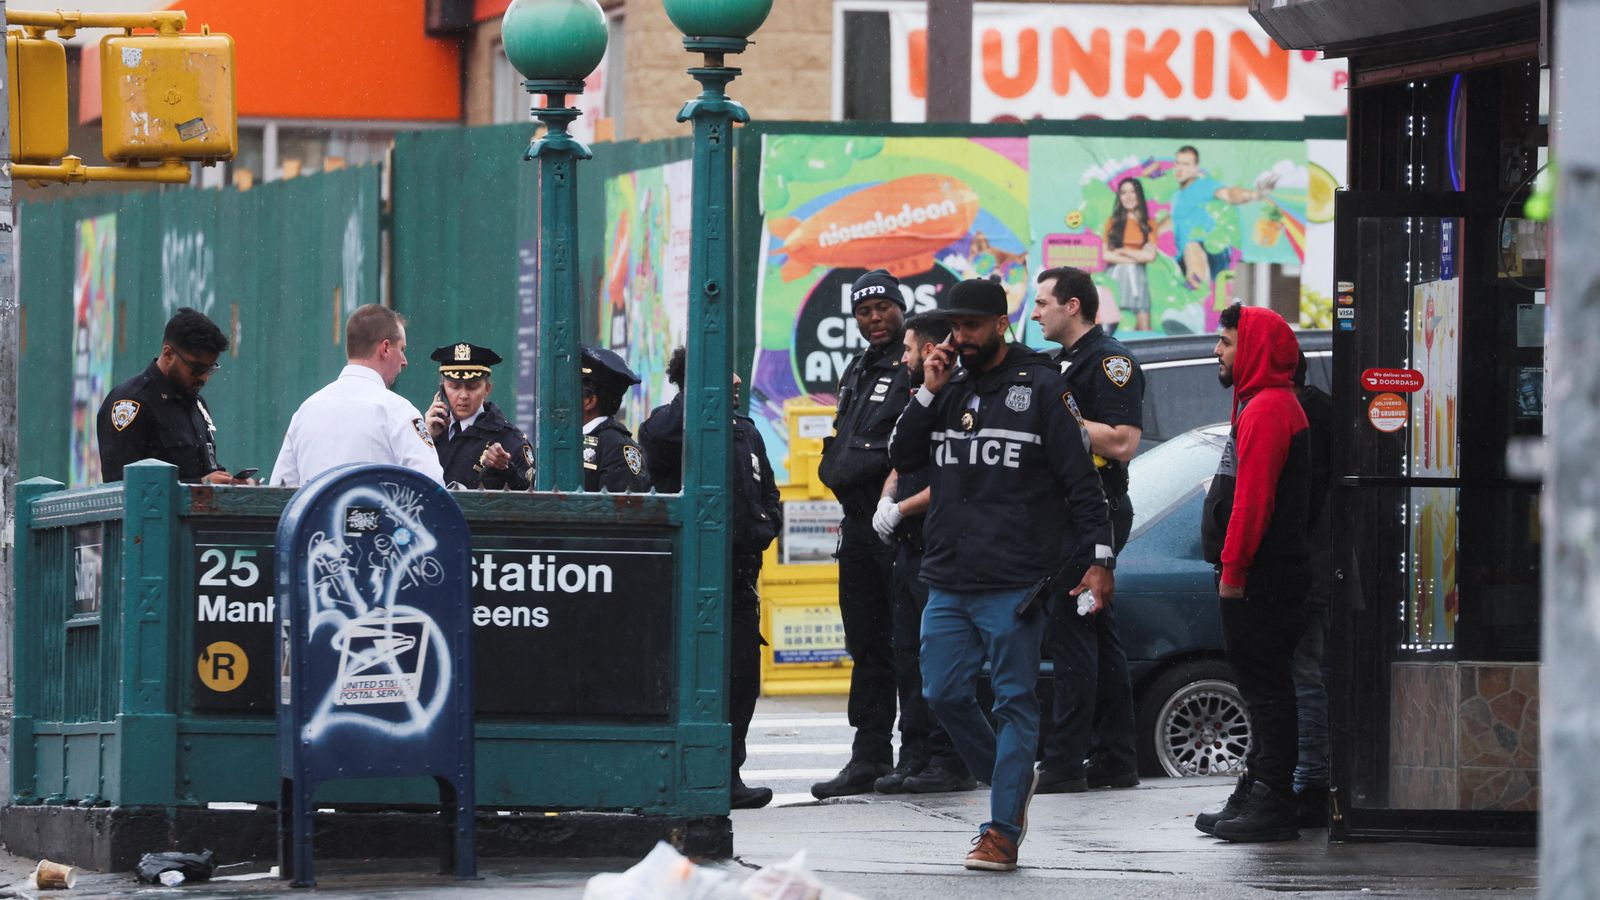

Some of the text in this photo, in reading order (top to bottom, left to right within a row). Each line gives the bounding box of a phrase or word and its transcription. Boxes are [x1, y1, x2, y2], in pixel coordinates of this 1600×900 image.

[818, 199, 957, 248] nickelodeon
[853, 285, 886, 301] NYPD
[199, 549, 260, 587] 25
[212, 652, 236, 680] R
[340, 689, 403, 700] POSTAL SERV
[342, 680, 377, 690] UNITED
